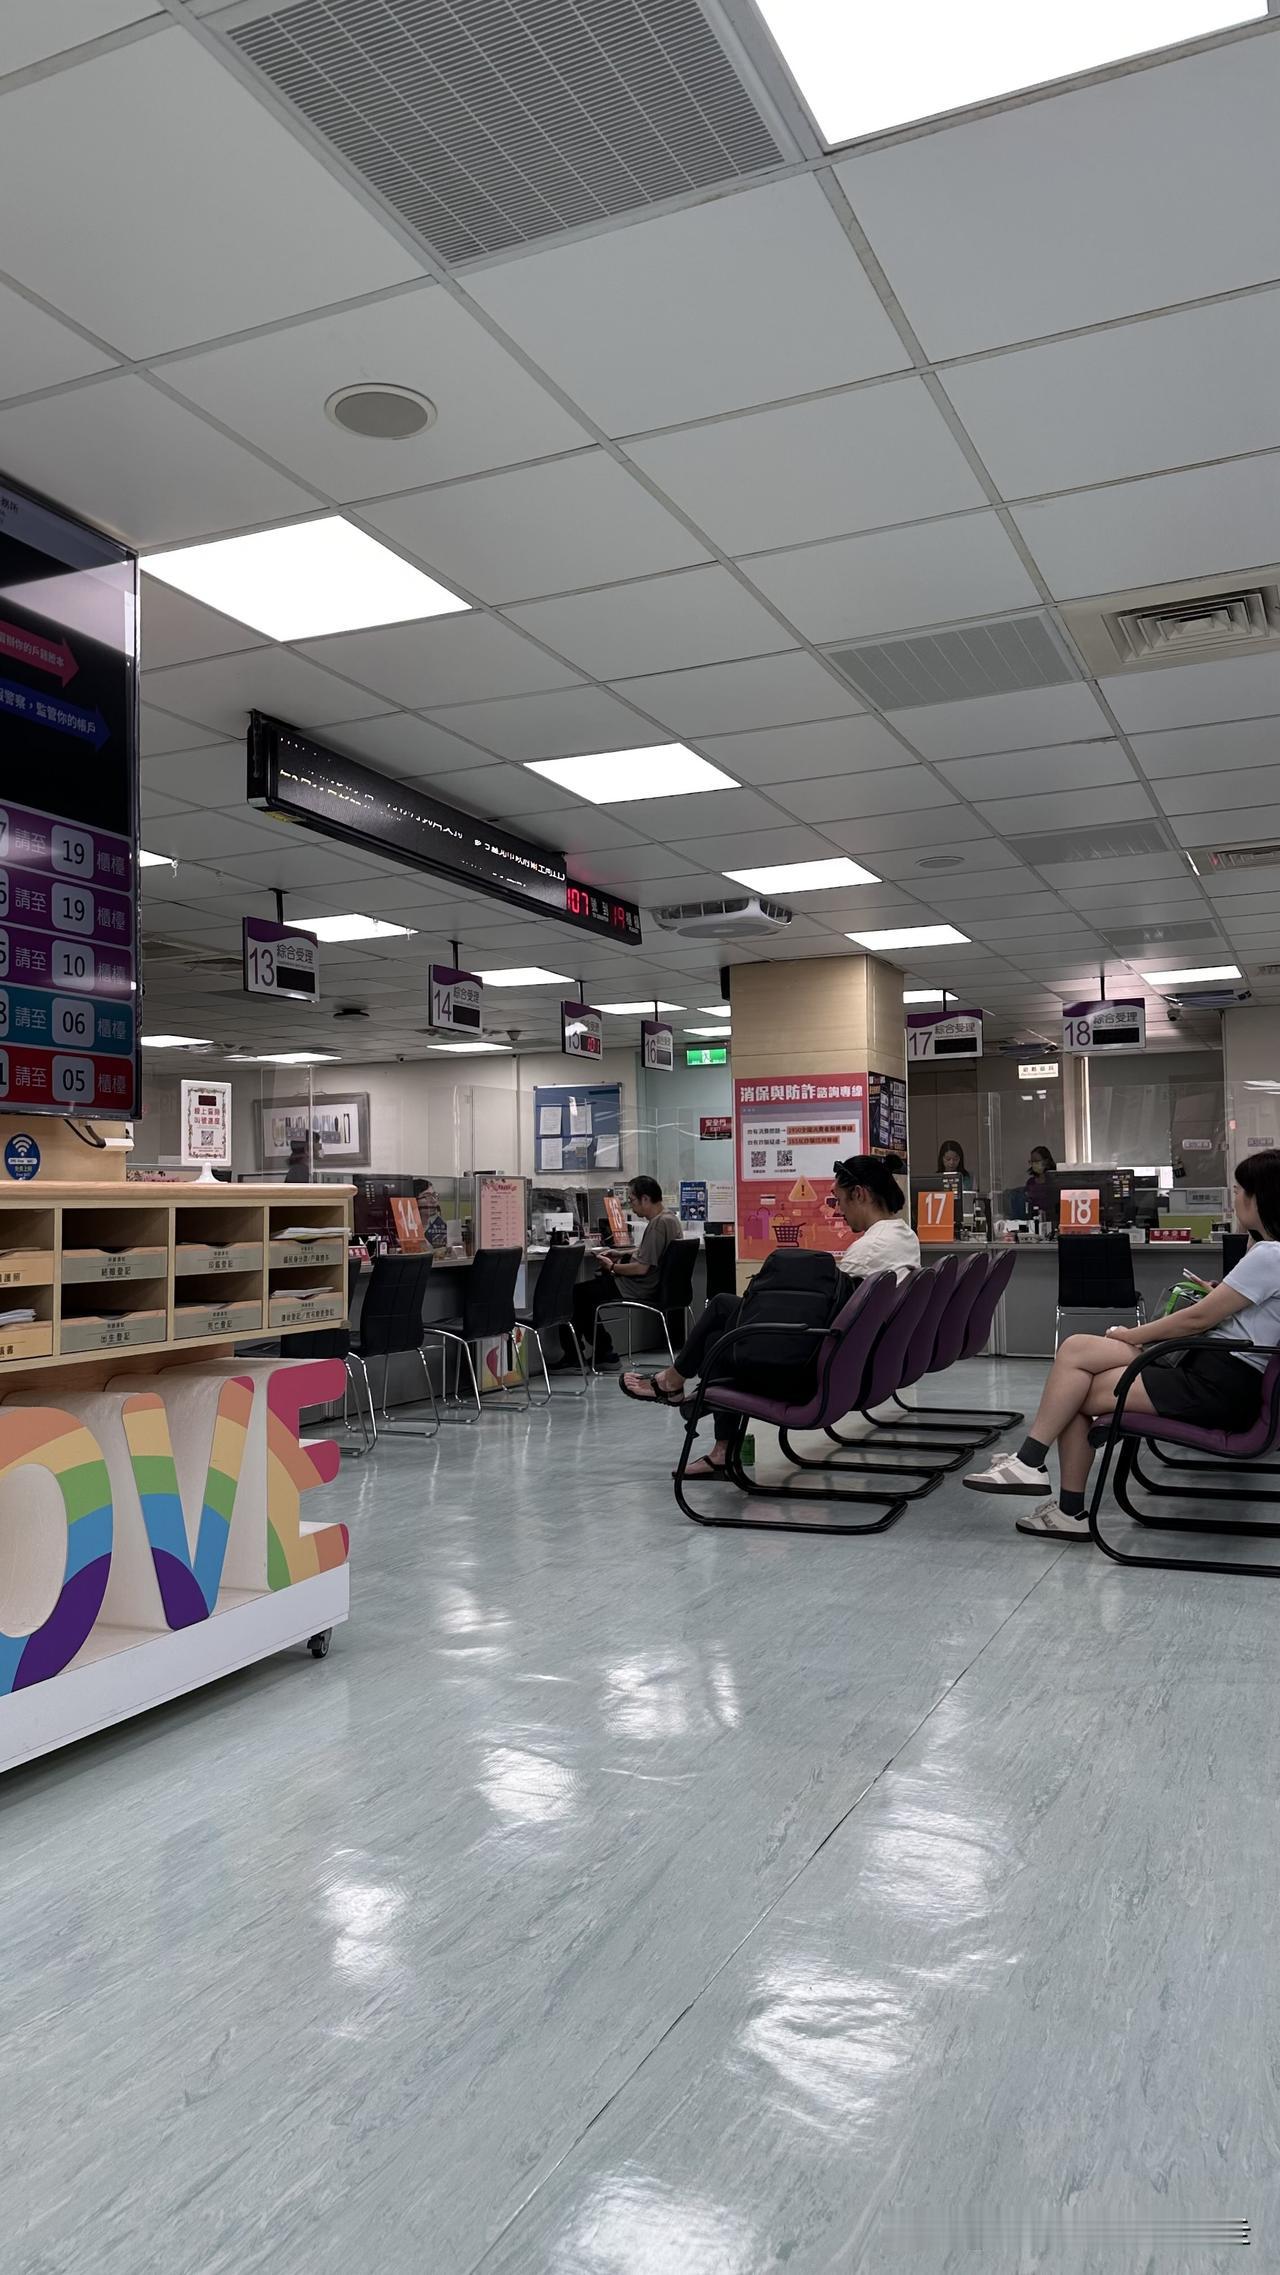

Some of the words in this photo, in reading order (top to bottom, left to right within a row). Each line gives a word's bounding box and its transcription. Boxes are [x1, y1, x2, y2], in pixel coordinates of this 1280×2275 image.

[15, 828, 47, 855] 請至
[62, 840, 85, 864] 19
[15, 887, 47, 913] 請至
[62, 897, 85, 921] 19
[567, 888, 589, 916] 107
[16, 947, 47, 971] 請至
[63, 954, 85, 977] 10
[249, 947, 275, 987] 13
[277, 944, 313, 964] 綜合受理
[434, 989, 452, 1022] 14
[453, 986, 480, 1004] 綜合受理
[16, 1007, 47, 1029] 請至
[63, 1011, 86, 1034] 06
[935, 1023, 975, 1034] 綜合受理
[1093, 1012, 1137, 1024] 綜合受理
[909, 1032, 933, 1055] 17
[1065, 1021, 1090, 1046] 18
[645, 1040, 657, 1063] 16
[16, 1066, 47, 1088] 請至
[63, 1069, 85, 1091] 05
[741, 1084, 863, 1102] 消保與防詐諮詢專線
[705, 1119, 727, 1127] 安全門
[398, 1200, 418, 1238] 14
[925, 1193, 946, 1225] 17
[1069, 1191, 1091, 1225] 18
